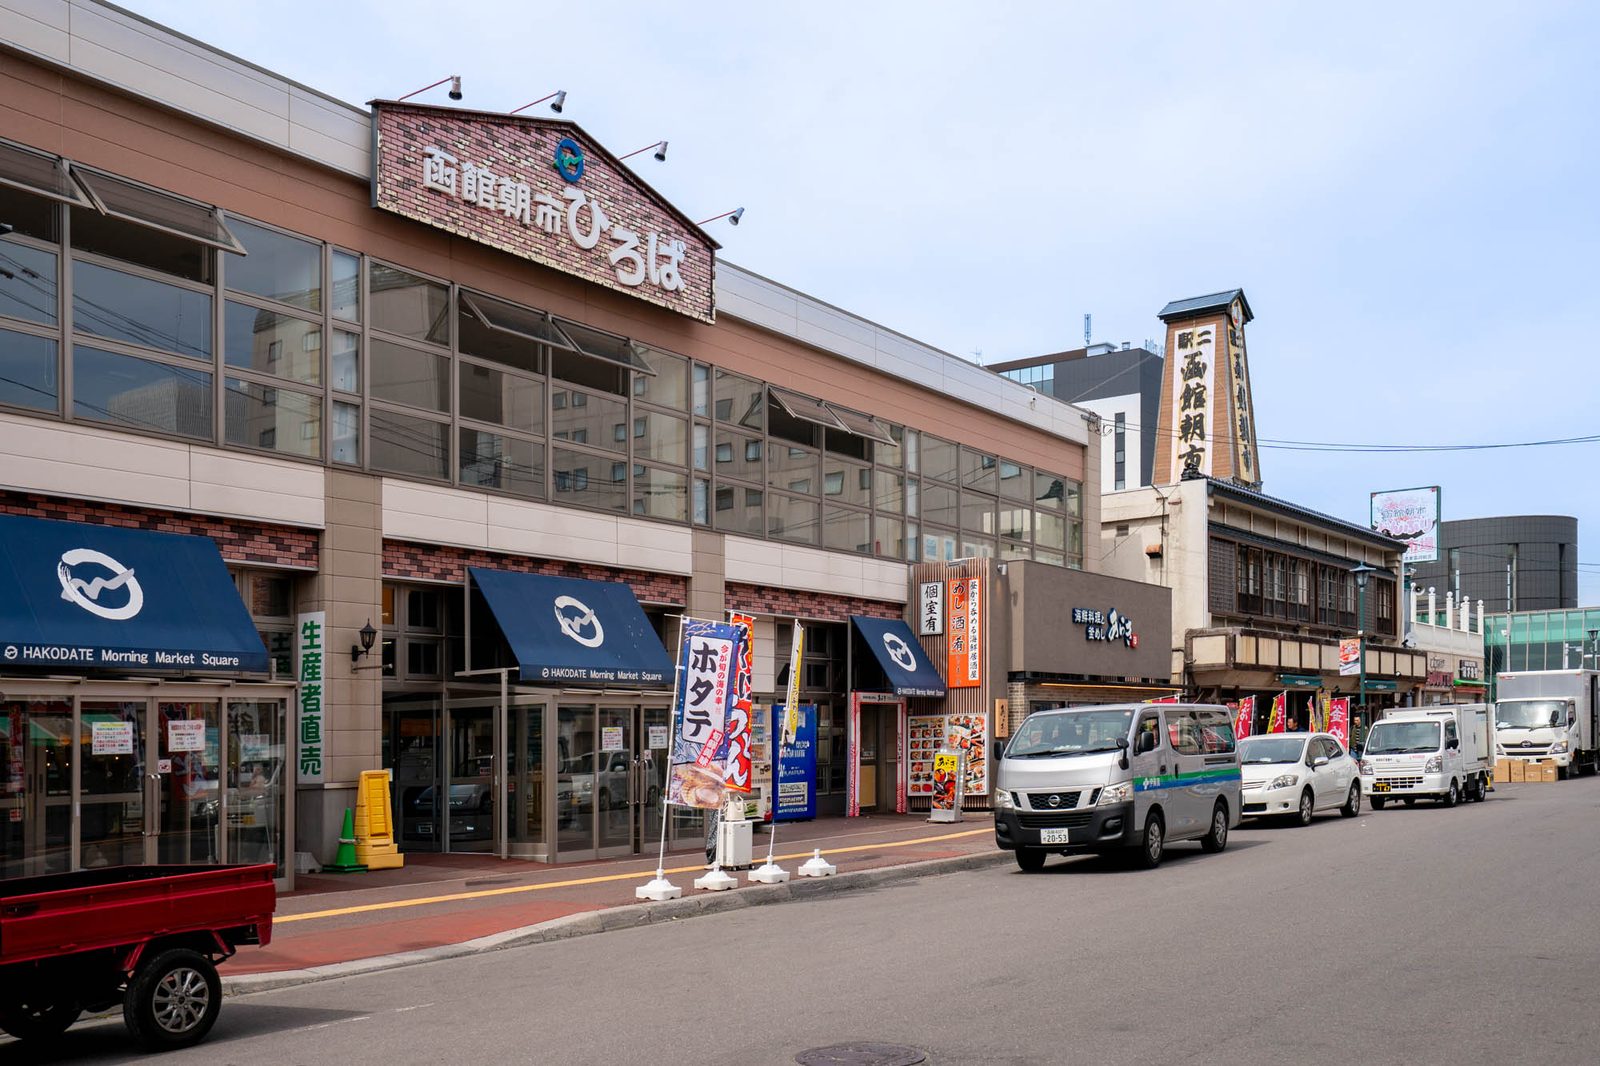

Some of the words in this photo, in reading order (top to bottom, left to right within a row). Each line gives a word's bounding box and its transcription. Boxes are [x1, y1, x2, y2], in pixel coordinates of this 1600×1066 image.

[422, 145, 687, 292] 函館朝市ひろば
[1178, 350, 1208, 474] 函館朝市
[925, 584, 939, 632] 個室有
[23, 646, 94, 662] HAKODATE
[101, 649, 149, 664] Morning
[155, 651, 196, 665] Market
[202, 653, 240, 667] Square
[550, 668, 587, 679] HAKODATE
[589, 670, 615, 681] Morning
[617, 670, 639, 680] Market
[641, 671, 663, 681] Square
[686, 640, 719, 738] ホタテ
[301, 620, 322, 776] 生産者直売
[1046, 834, 1068, 843] 20-53
